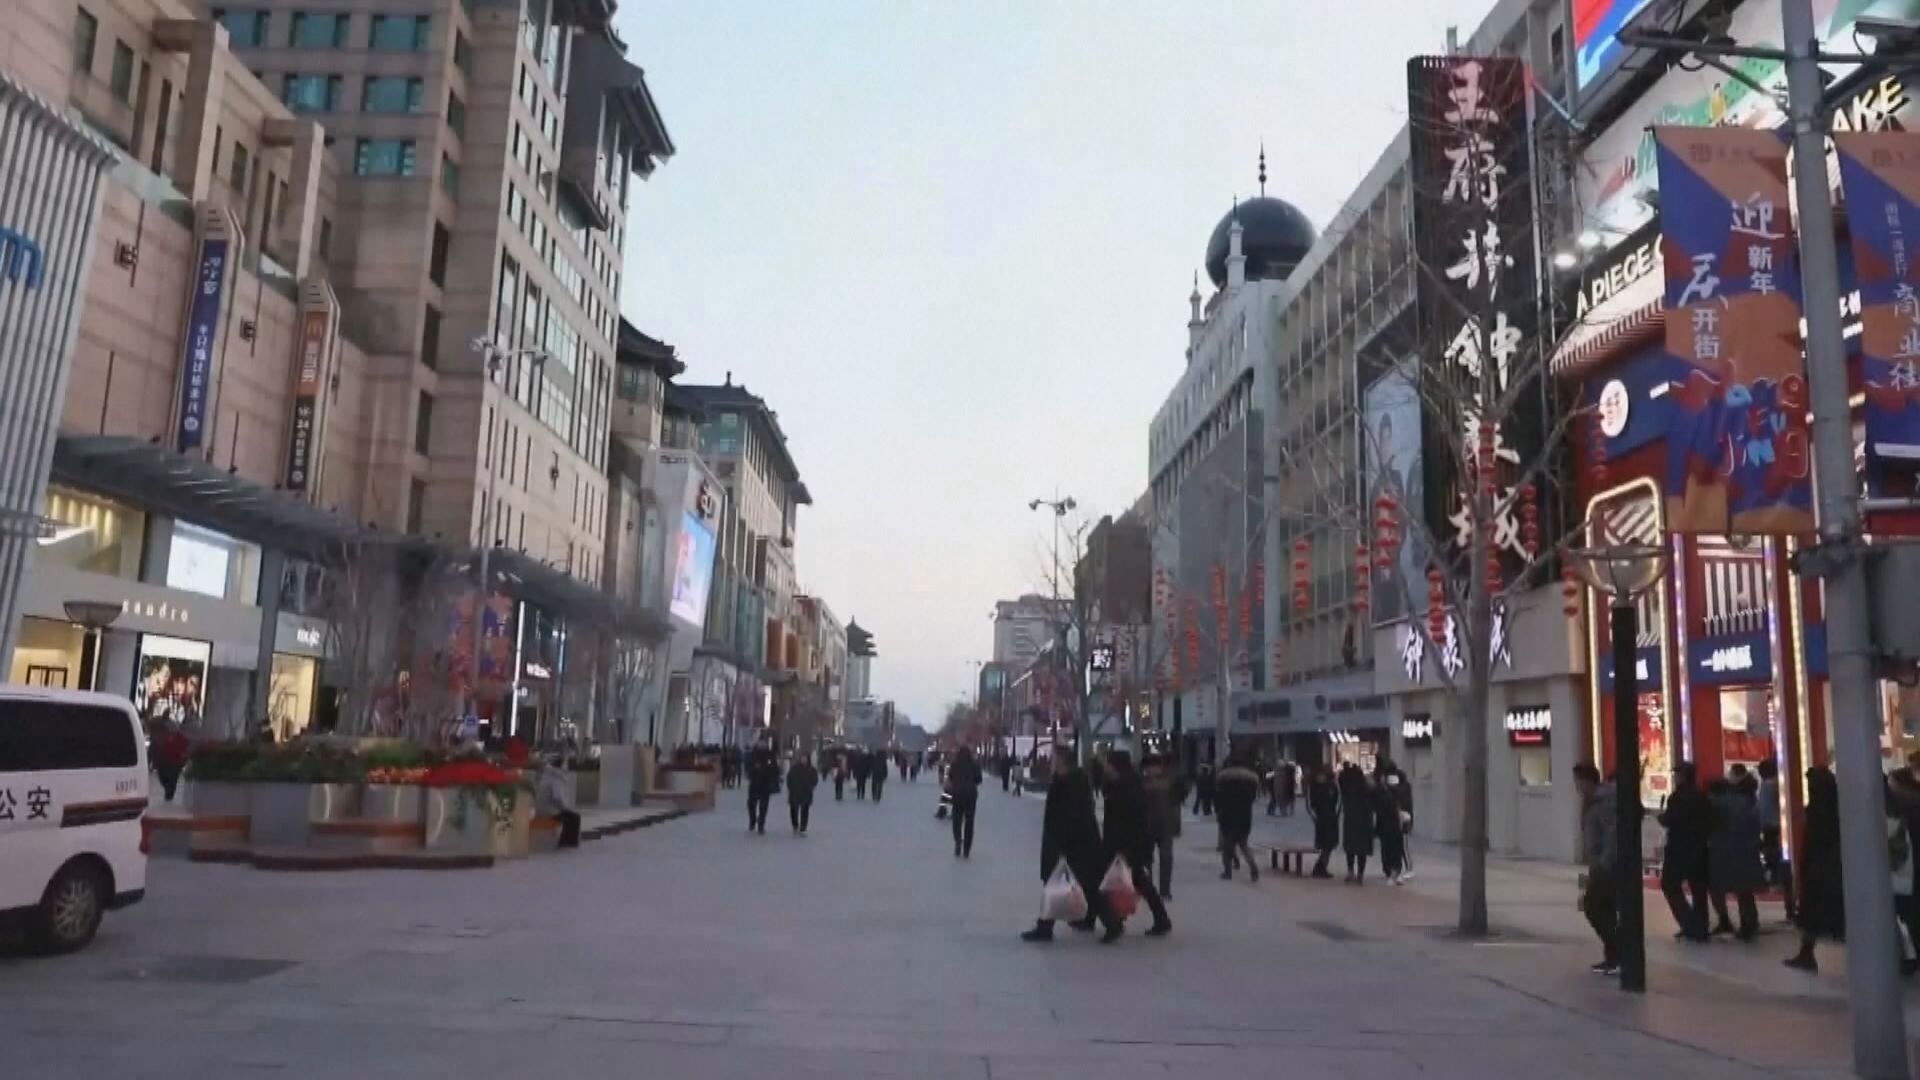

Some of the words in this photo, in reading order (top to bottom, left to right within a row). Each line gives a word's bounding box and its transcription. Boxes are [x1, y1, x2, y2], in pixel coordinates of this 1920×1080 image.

[1832, 75, 1903, 132] AKE
[1730, 191, 1785, 295] 迎新年
[1576, 289, 1588, 320] A
[1592, 242, 1649, 309] PIECE
[0, 785, 51, 820] 公安
